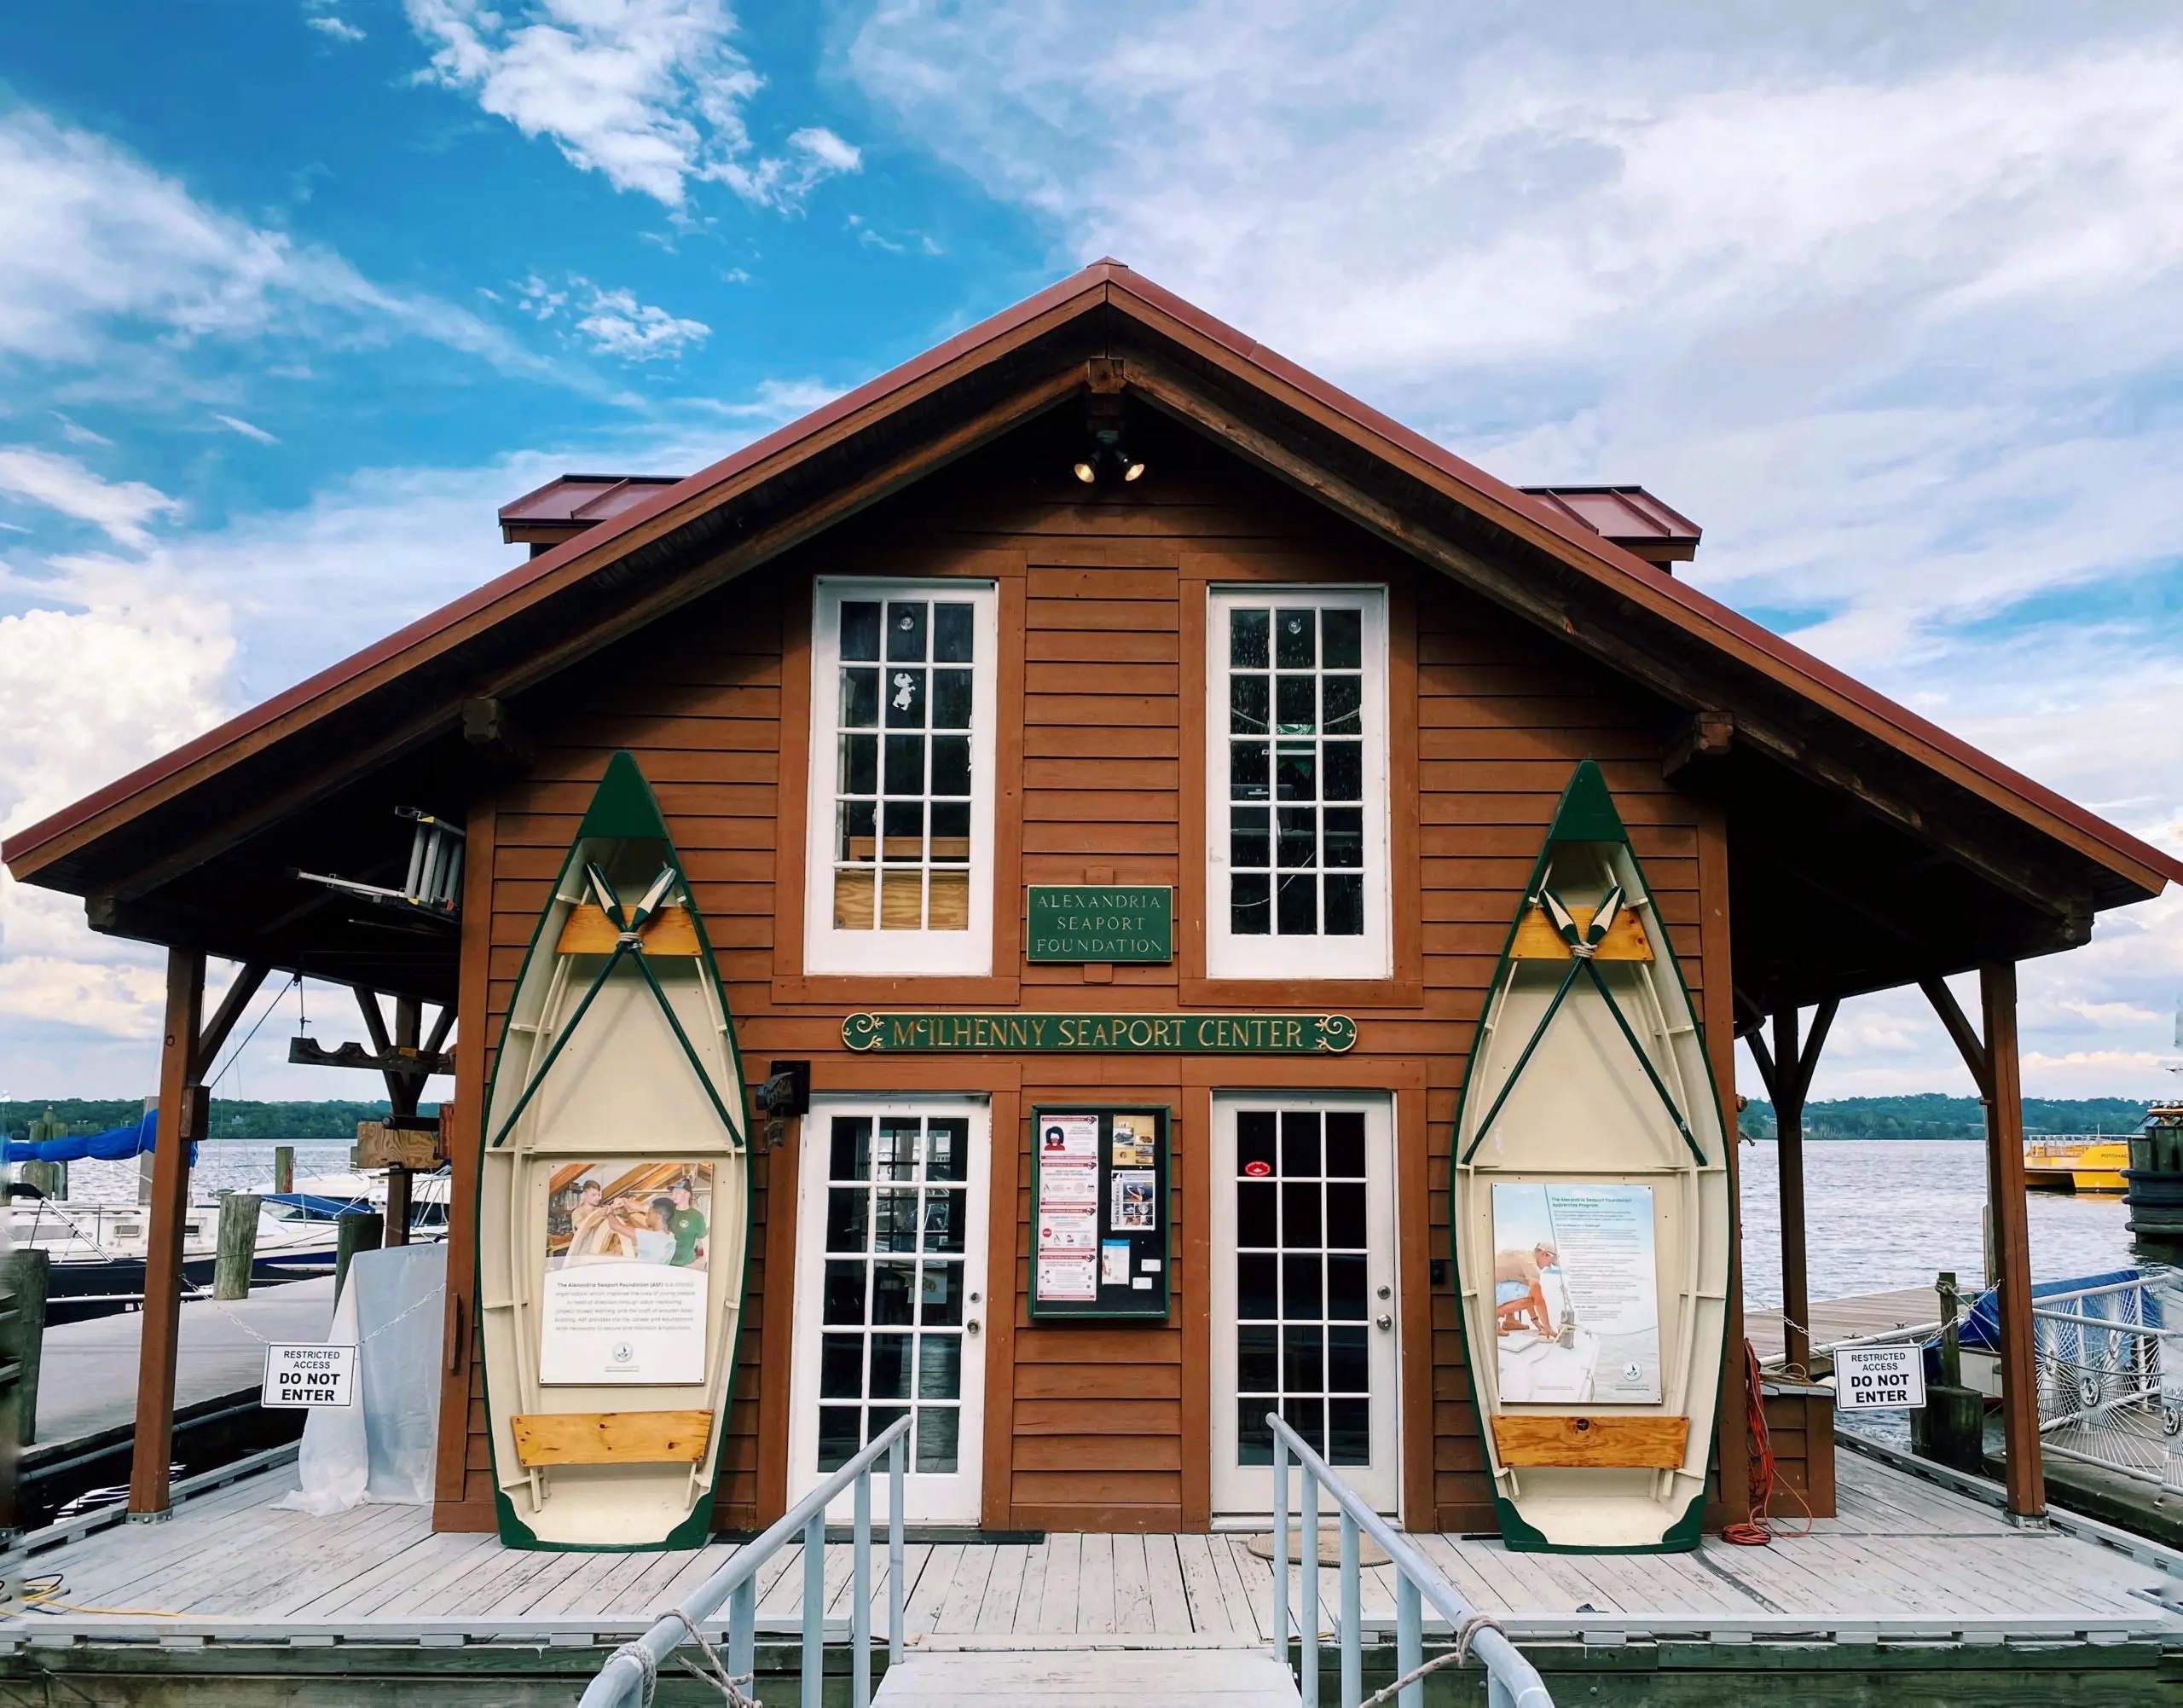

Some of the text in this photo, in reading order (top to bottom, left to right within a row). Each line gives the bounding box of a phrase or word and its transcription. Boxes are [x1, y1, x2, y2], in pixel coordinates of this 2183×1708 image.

[1037, 895, 1161, 908] ALEXANDRIA
[1057, 916, 1145, 930] SEAPORT
[1036, 939, 1162, 952] FOUNDATION
[1057, 1019, 1186, 1046] SEAPORT
[1197, 1019, 1304, 1047] CENTER
[1851, 1352, 1905, 1362] RESTRICTED
[1862, 1363, 1898, 1371] ACCESS
[280, 1373, 340, 1385] DO NOT
[1851, 1374, 1909, 1387] DO NOT
[281, 1388, 335, 1401] ENTER
[1856, 1390, 1908, 1403] ENTER
